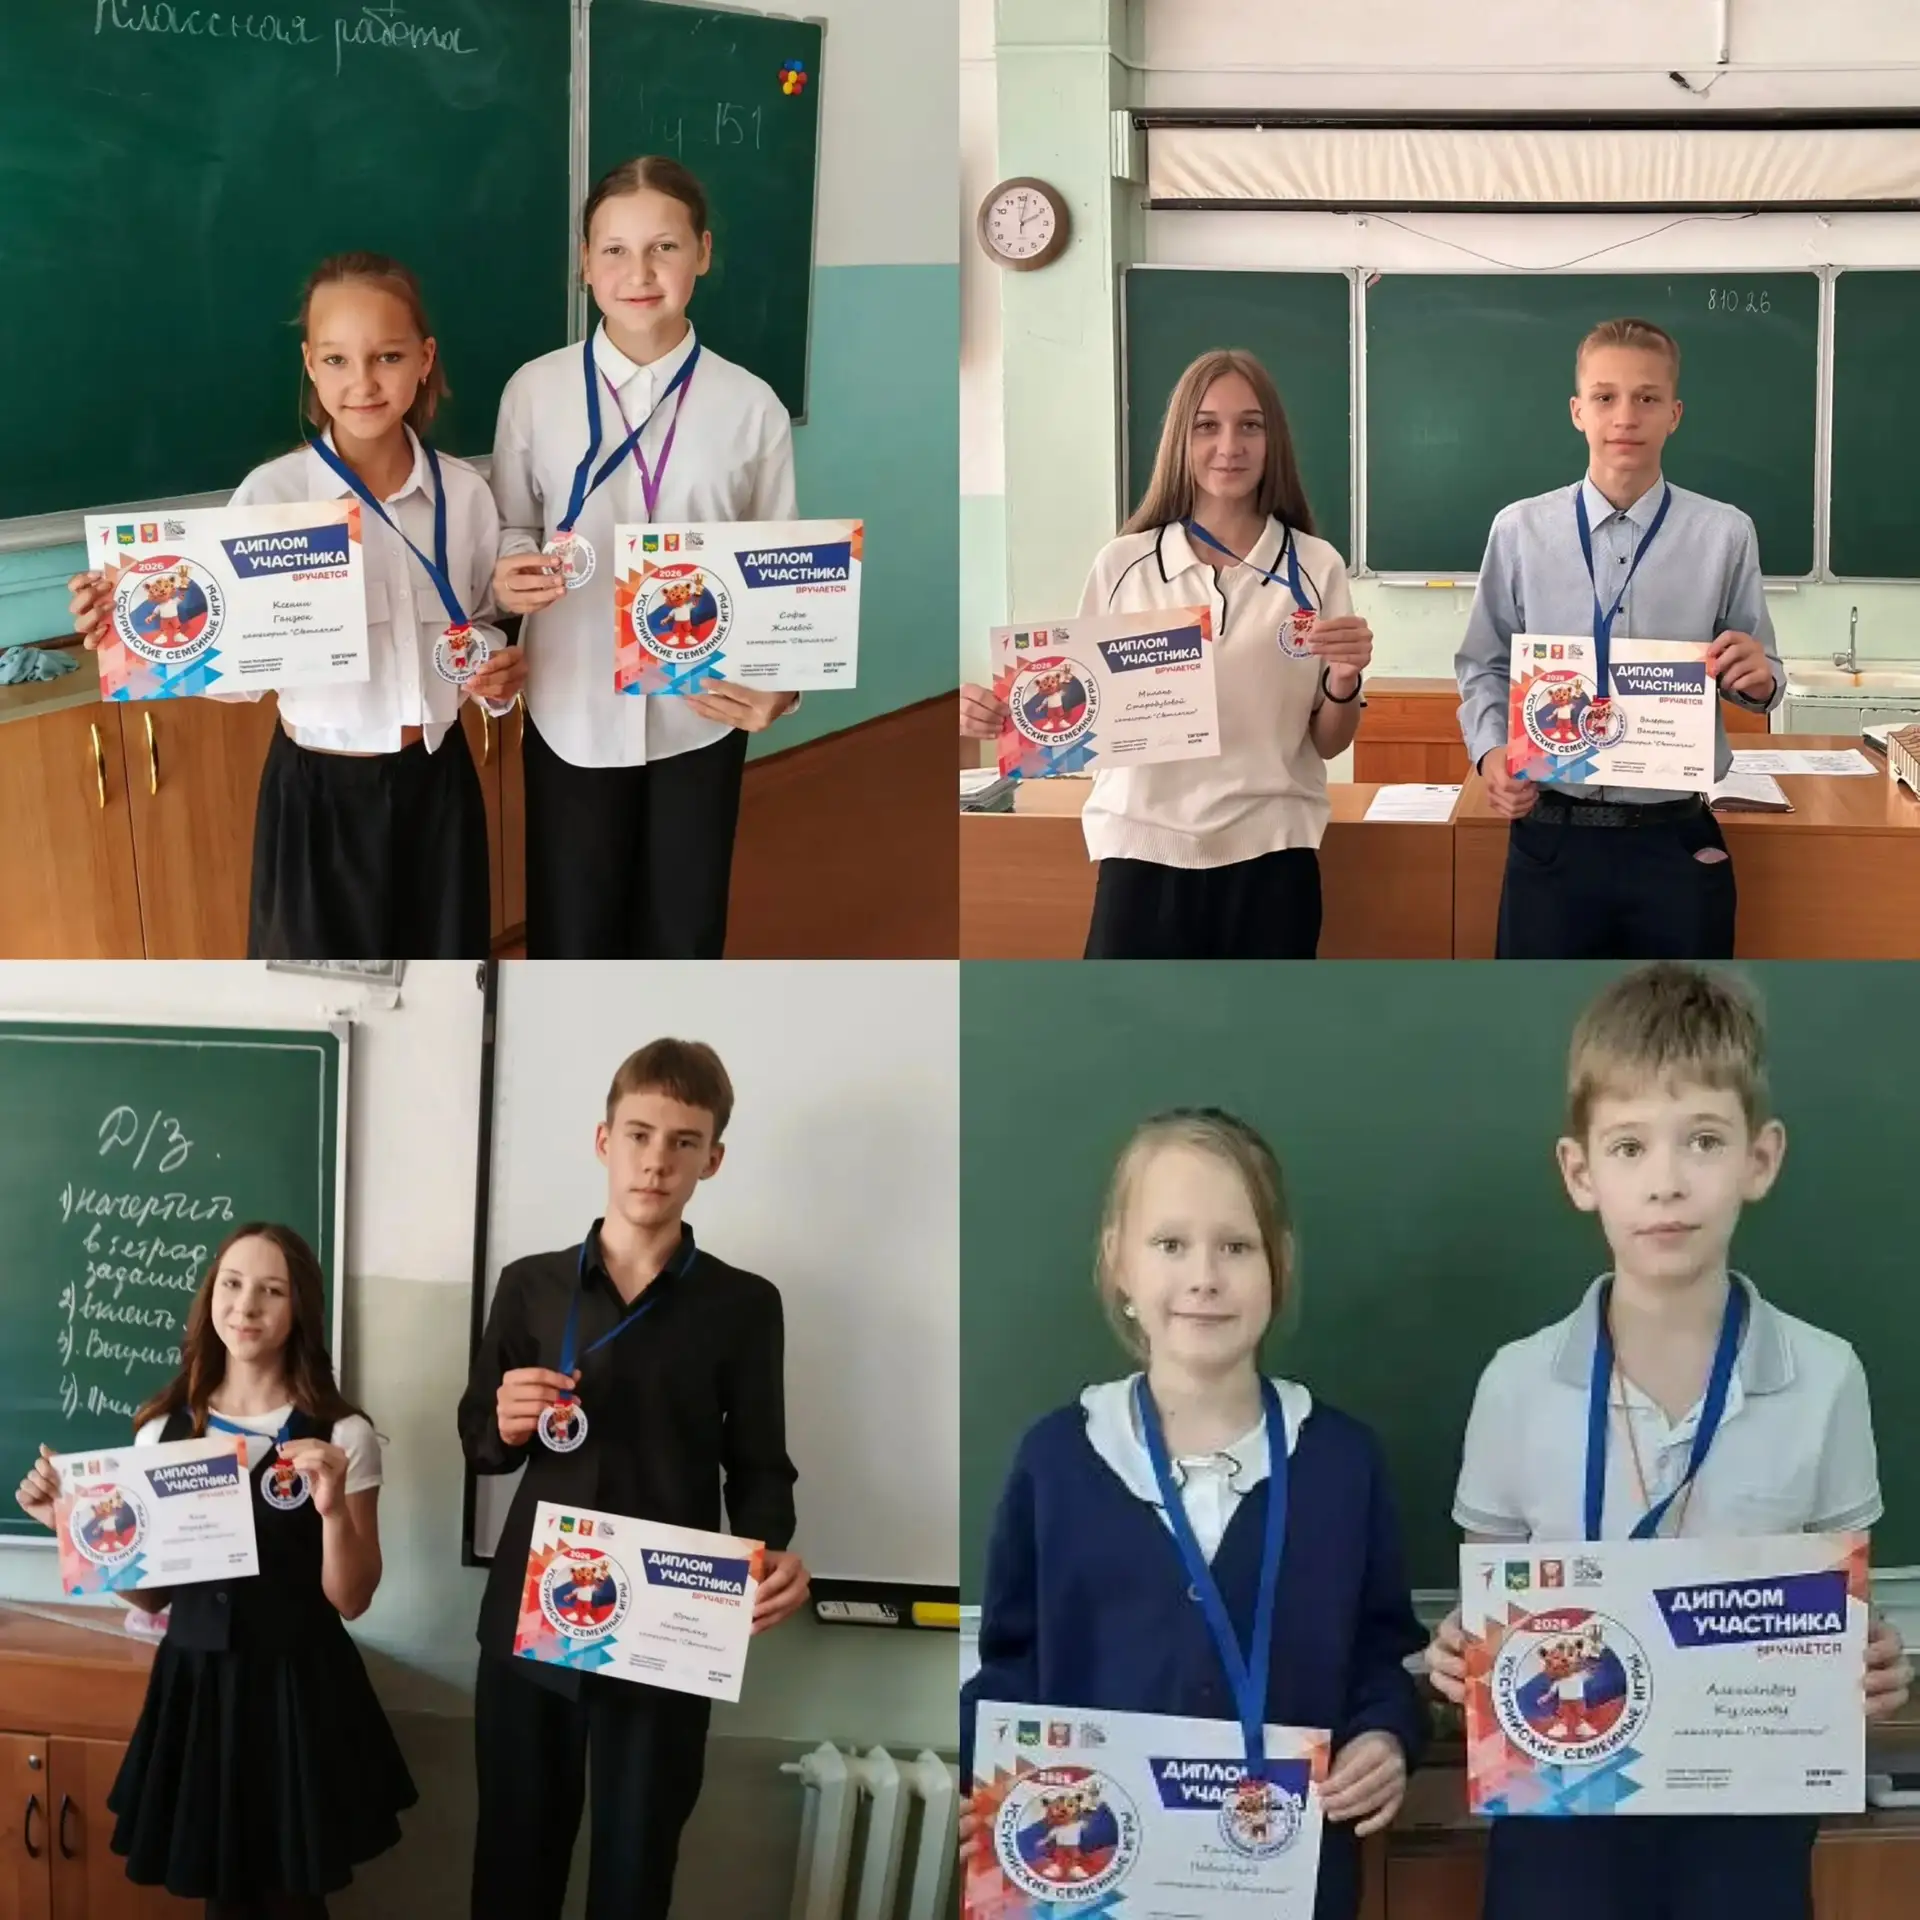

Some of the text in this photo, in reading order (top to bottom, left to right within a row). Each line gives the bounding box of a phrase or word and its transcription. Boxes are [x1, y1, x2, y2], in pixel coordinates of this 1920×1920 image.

[335, 1, 478, 78] работа
[716, 102, 762, 150] 151
[233, 536, 308, 556] ДИПЛОМ
[139, 562, 164, 572] 2026
[249, 551, 347, 570] УЧАСТНИКА
[744, 552, 813, 567] ДИПЛОМ
[292, 570, 348, 582] ВРУЧАЕТСЯ
[660, 570, 682, 578] 2026
[759, 568, 847, 581] УЧАСТНИКА
[796, 585, 847, 594] ВРУЧАЕТСЯ
[718, 593, 729, 622] ИГРЫ
[166, 618, 219, 659] СЕМЕЙНЫЕ
[208, 584, 221, 617] ИГРЫ
[1107, 638, 1168, 655] ДИПЛОМ
[1120, 648, 1200, 666] УЧАСТНИКА
[1155, 664, 1201, 675] ВРУЧАЕТСЯ
[1616, 666, 1674, 678] ДИПЛОМ
[1628, 680, 1703, 693] УЧАСТНИКА
[1052, 708, 1096, 743] СЕМЕЙНЫЕ
[1086, 678, 1097, 707] ИГРЫ
[82, 1222, 101, 1253] в
[153, 1464, 209, 1481] ДИПЛОМ
[165, 1474, 237, 1492] УЧАСТНИКА
[649, 1552, 713, 1573] ДИПЛОМ
[660, 1569, 743, 1594] УЧАСТНИКА
[619, 1582, 628, 1609] ИГРЫ
[1671, 1588, 1784, 1612] ДИПЛОМ
[1693, 1612, 1842, 1636] УЧАСТНИКА
[1627, 1654, 1645, 1701] ИГРЫ
